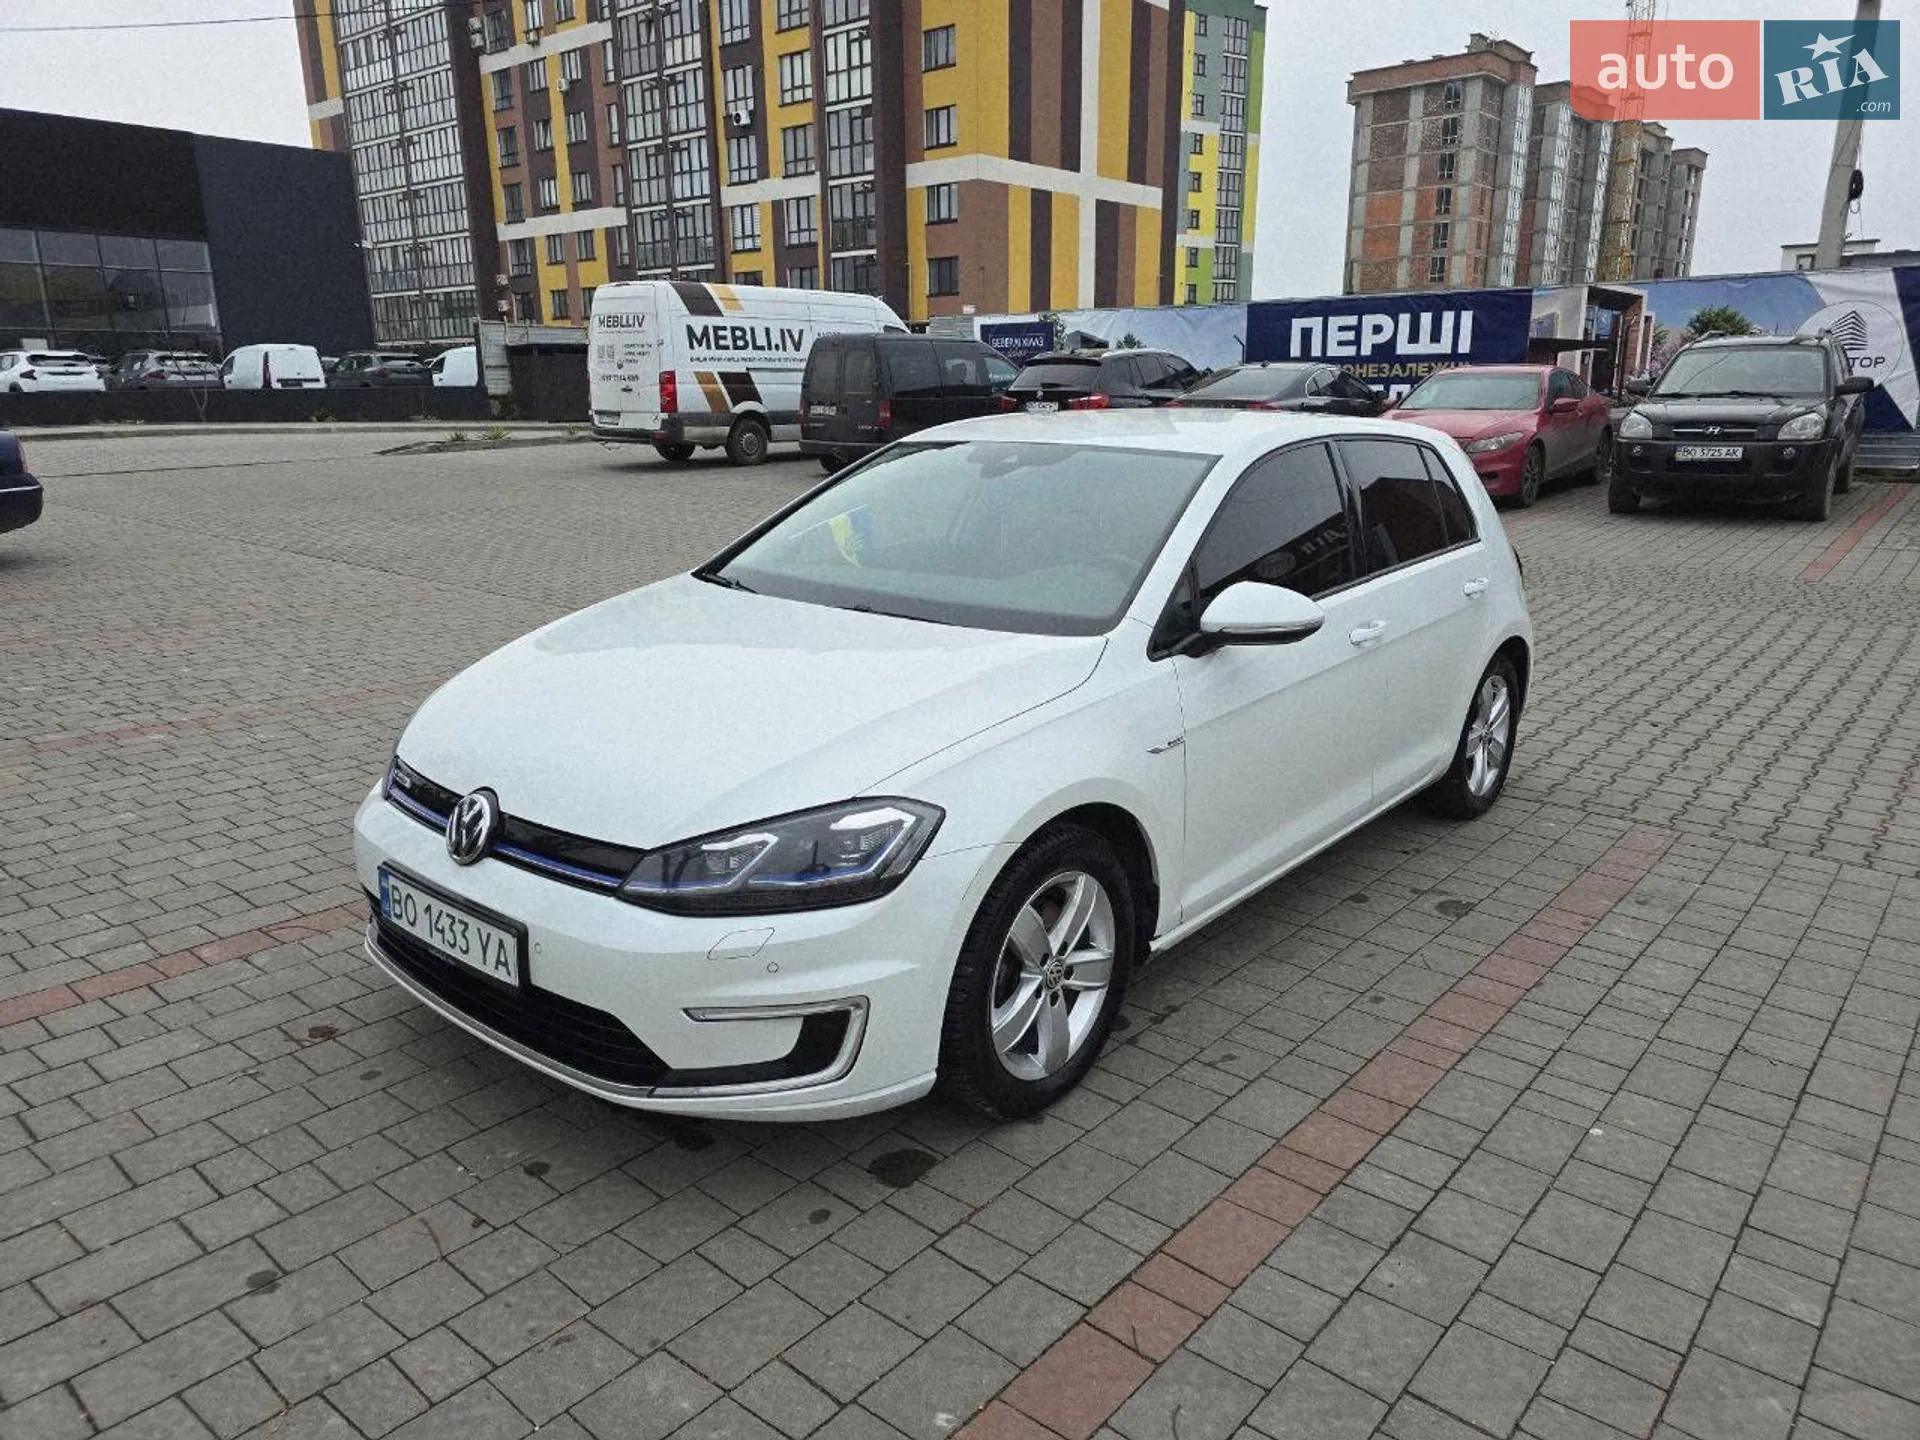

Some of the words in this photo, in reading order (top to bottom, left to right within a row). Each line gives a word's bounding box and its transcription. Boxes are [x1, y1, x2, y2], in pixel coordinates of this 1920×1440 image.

[685, 323, 805, 352] MEBLI.IV
[1290, 311, 1473, 358] ПЕРШІ
[391, 884, 417, 928] BO
[422, 902, 470, 955] 1433
[477, 926, 511, 977] YA
